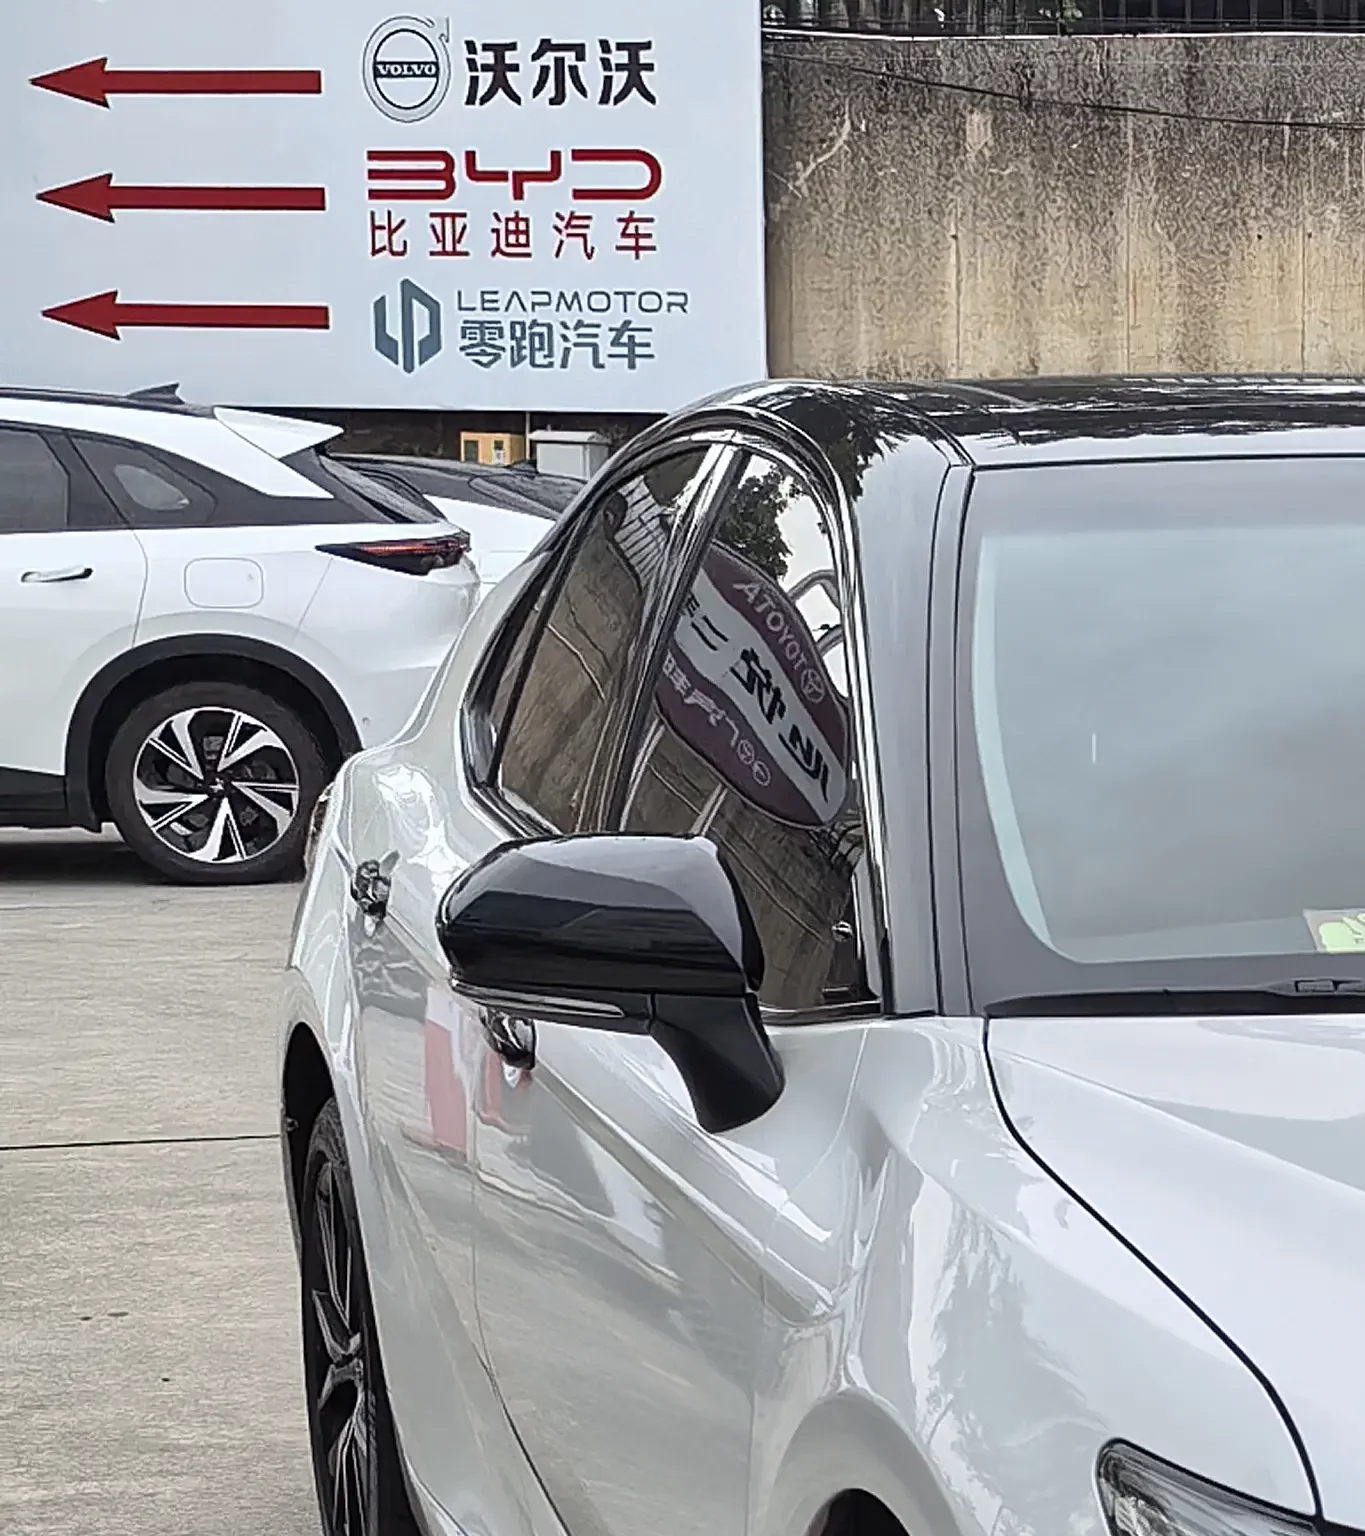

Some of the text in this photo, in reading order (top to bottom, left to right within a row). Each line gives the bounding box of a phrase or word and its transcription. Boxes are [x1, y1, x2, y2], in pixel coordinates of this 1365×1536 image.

[377, 63, 436, 76] VOLVO
[464, 38, 657, 107] 沃尔沃
[367, 149, 661, 201] BYD
[369, 210, 658, 260] 比亚迪汽车
[457, 290, 689, 314] LEAPMOTOR
[459, 320, 655, 370] 零跑汽车
